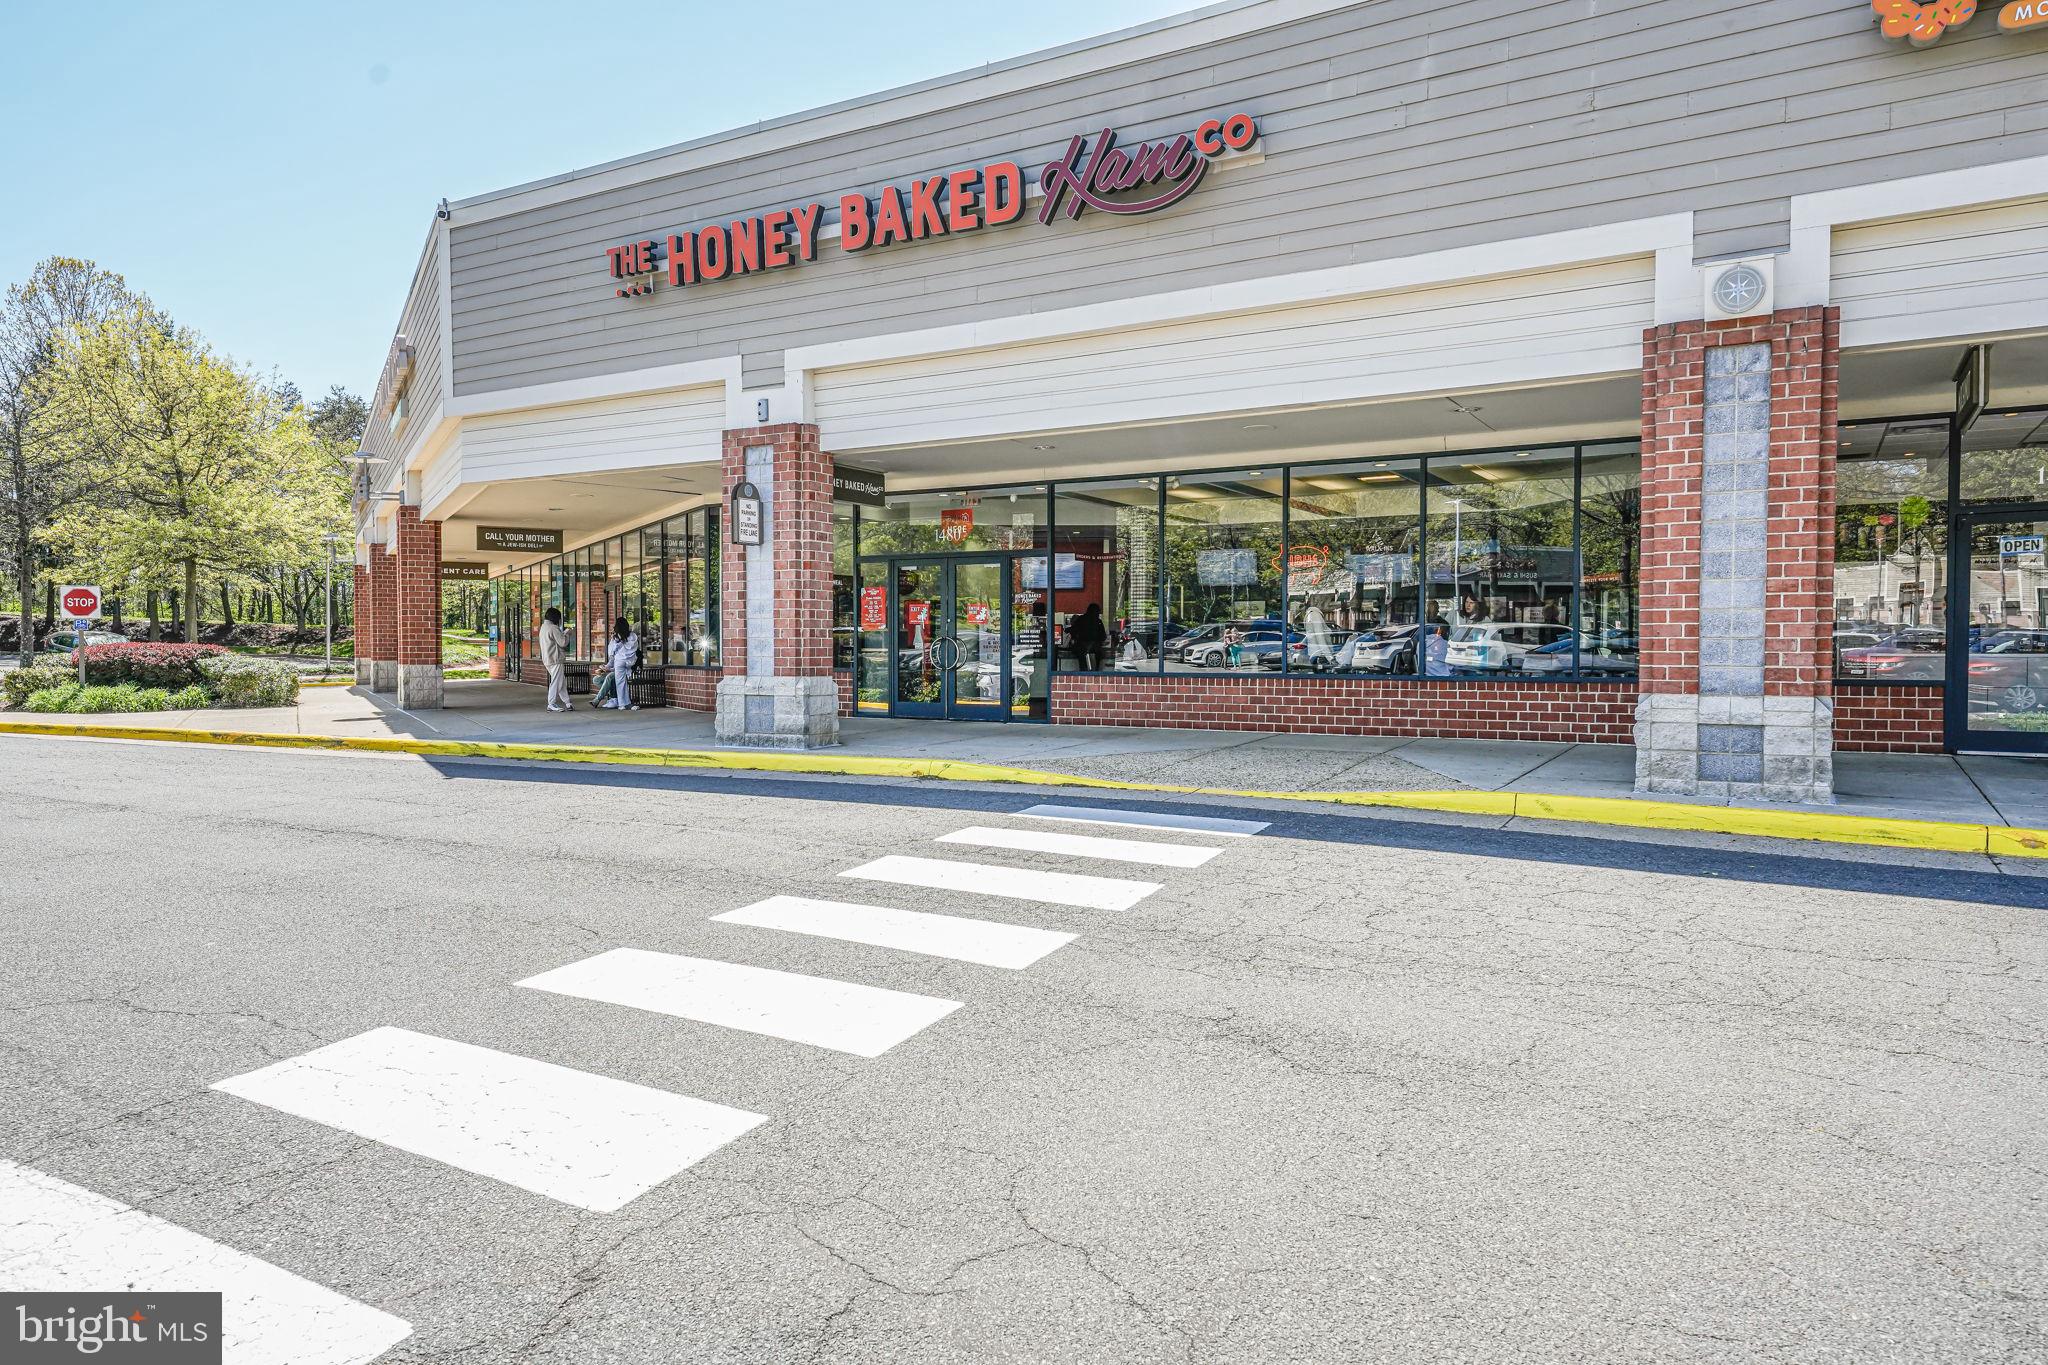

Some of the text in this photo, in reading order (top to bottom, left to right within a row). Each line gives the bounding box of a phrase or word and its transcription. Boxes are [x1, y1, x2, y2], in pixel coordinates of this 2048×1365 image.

[606, 113, 1258, 286] THE HONEY BAKED Ham CO
[844, 480, 865, 492] BAKED
[485, 532, 555, 543] CALL YOUR MOTHER
[740, 528, 758, 537] FIRE LANE
[2004, 539, 2040, 552] OPEN
[67, 597, 95, 607] STOP
